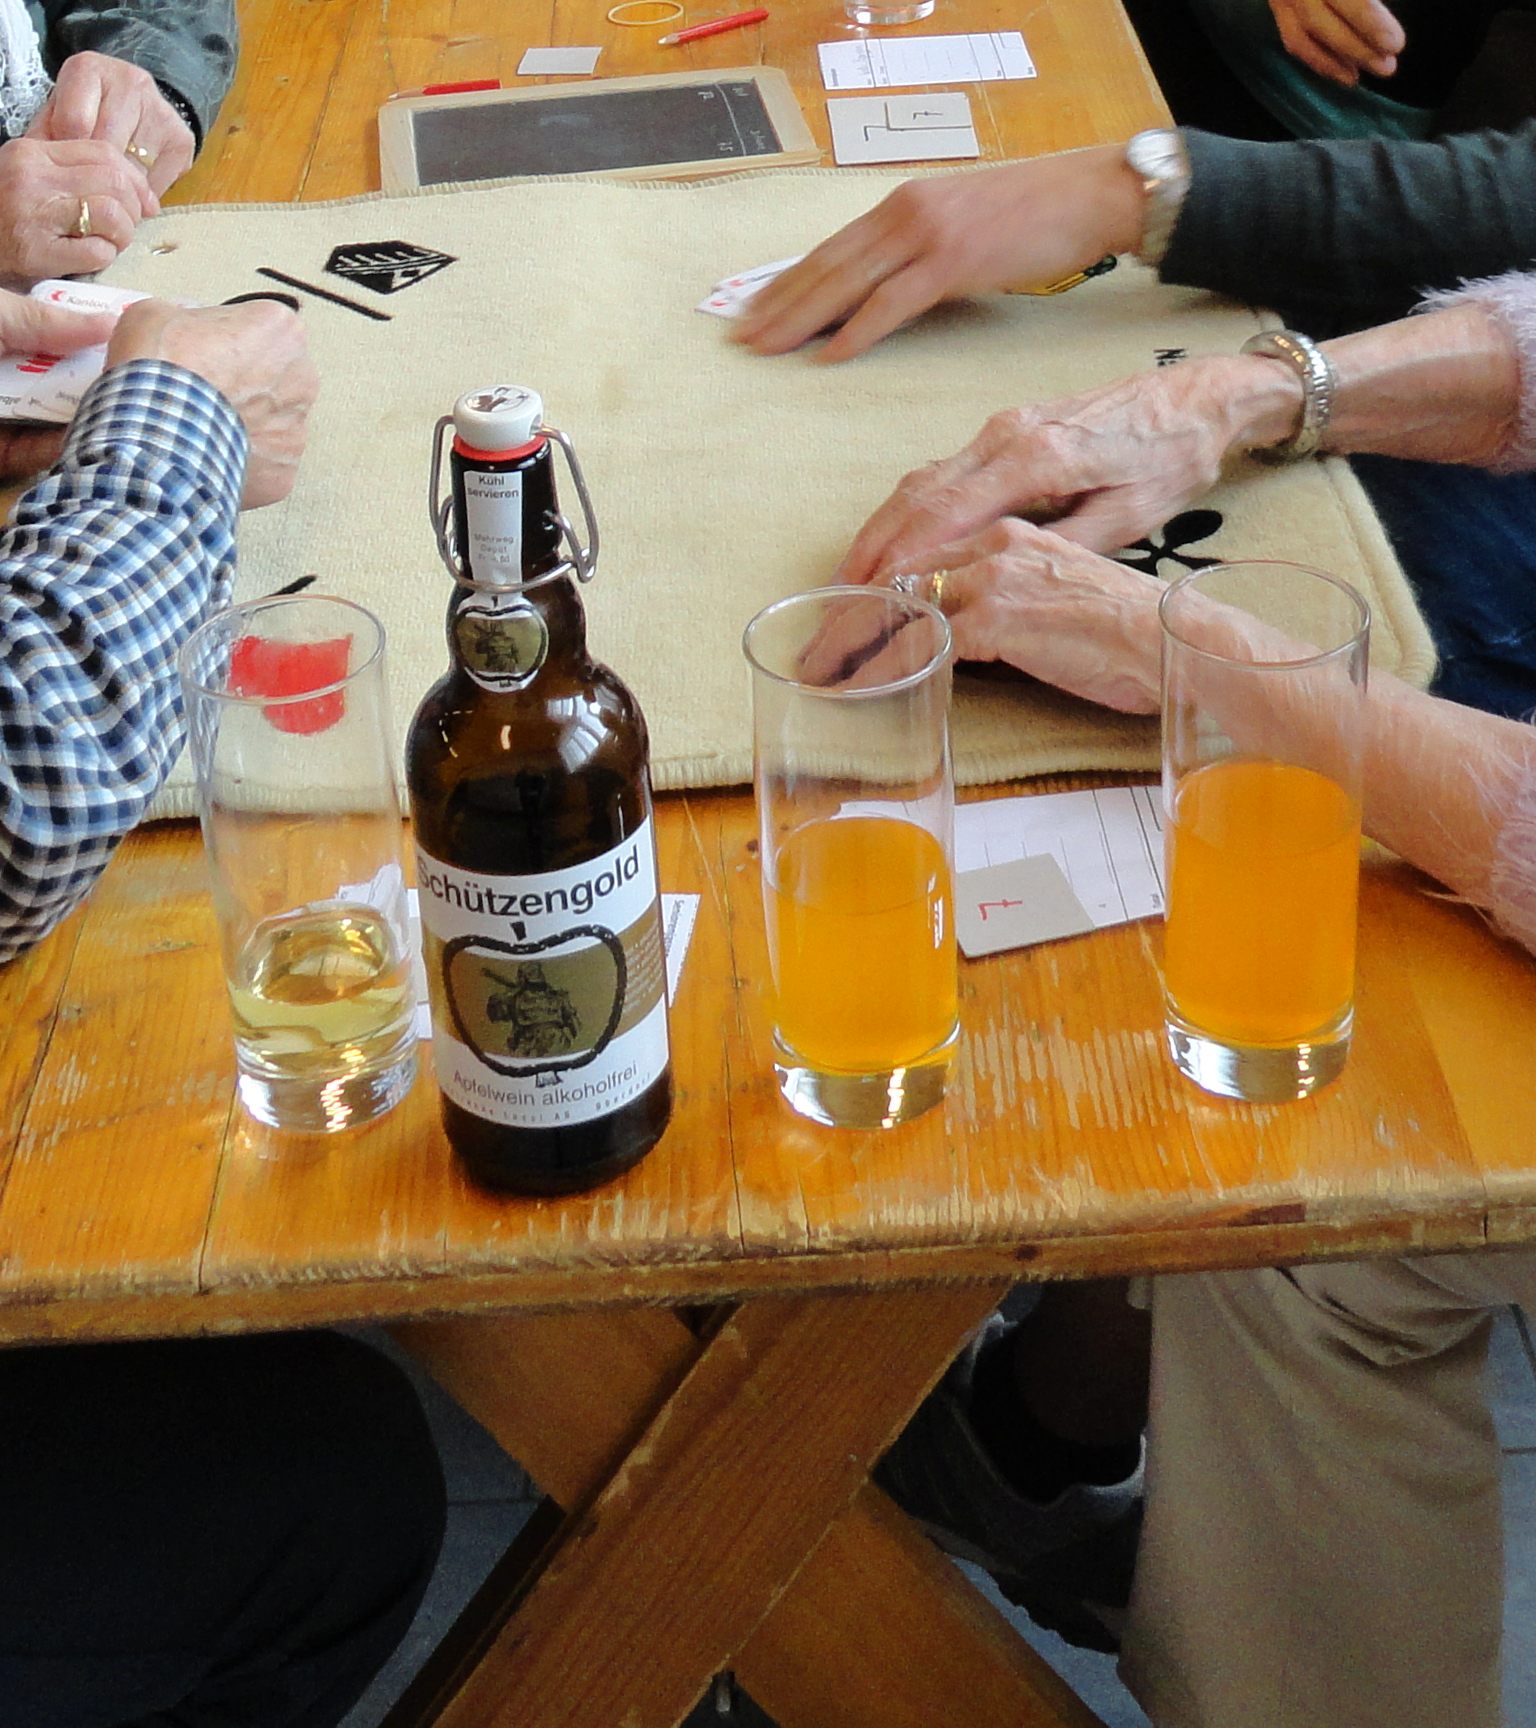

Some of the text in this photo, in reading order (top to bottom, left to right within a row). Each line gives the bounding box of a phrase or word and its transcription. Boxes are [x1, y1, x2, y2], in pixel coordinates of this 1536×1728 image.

[467, 487, 520, 499] servieren
[478, 474, 505, 486] Kühl
[416, 843, 640, 917] Schützengold
[452, 1061, 638, 1106] Apfelwein alkoholfrei
